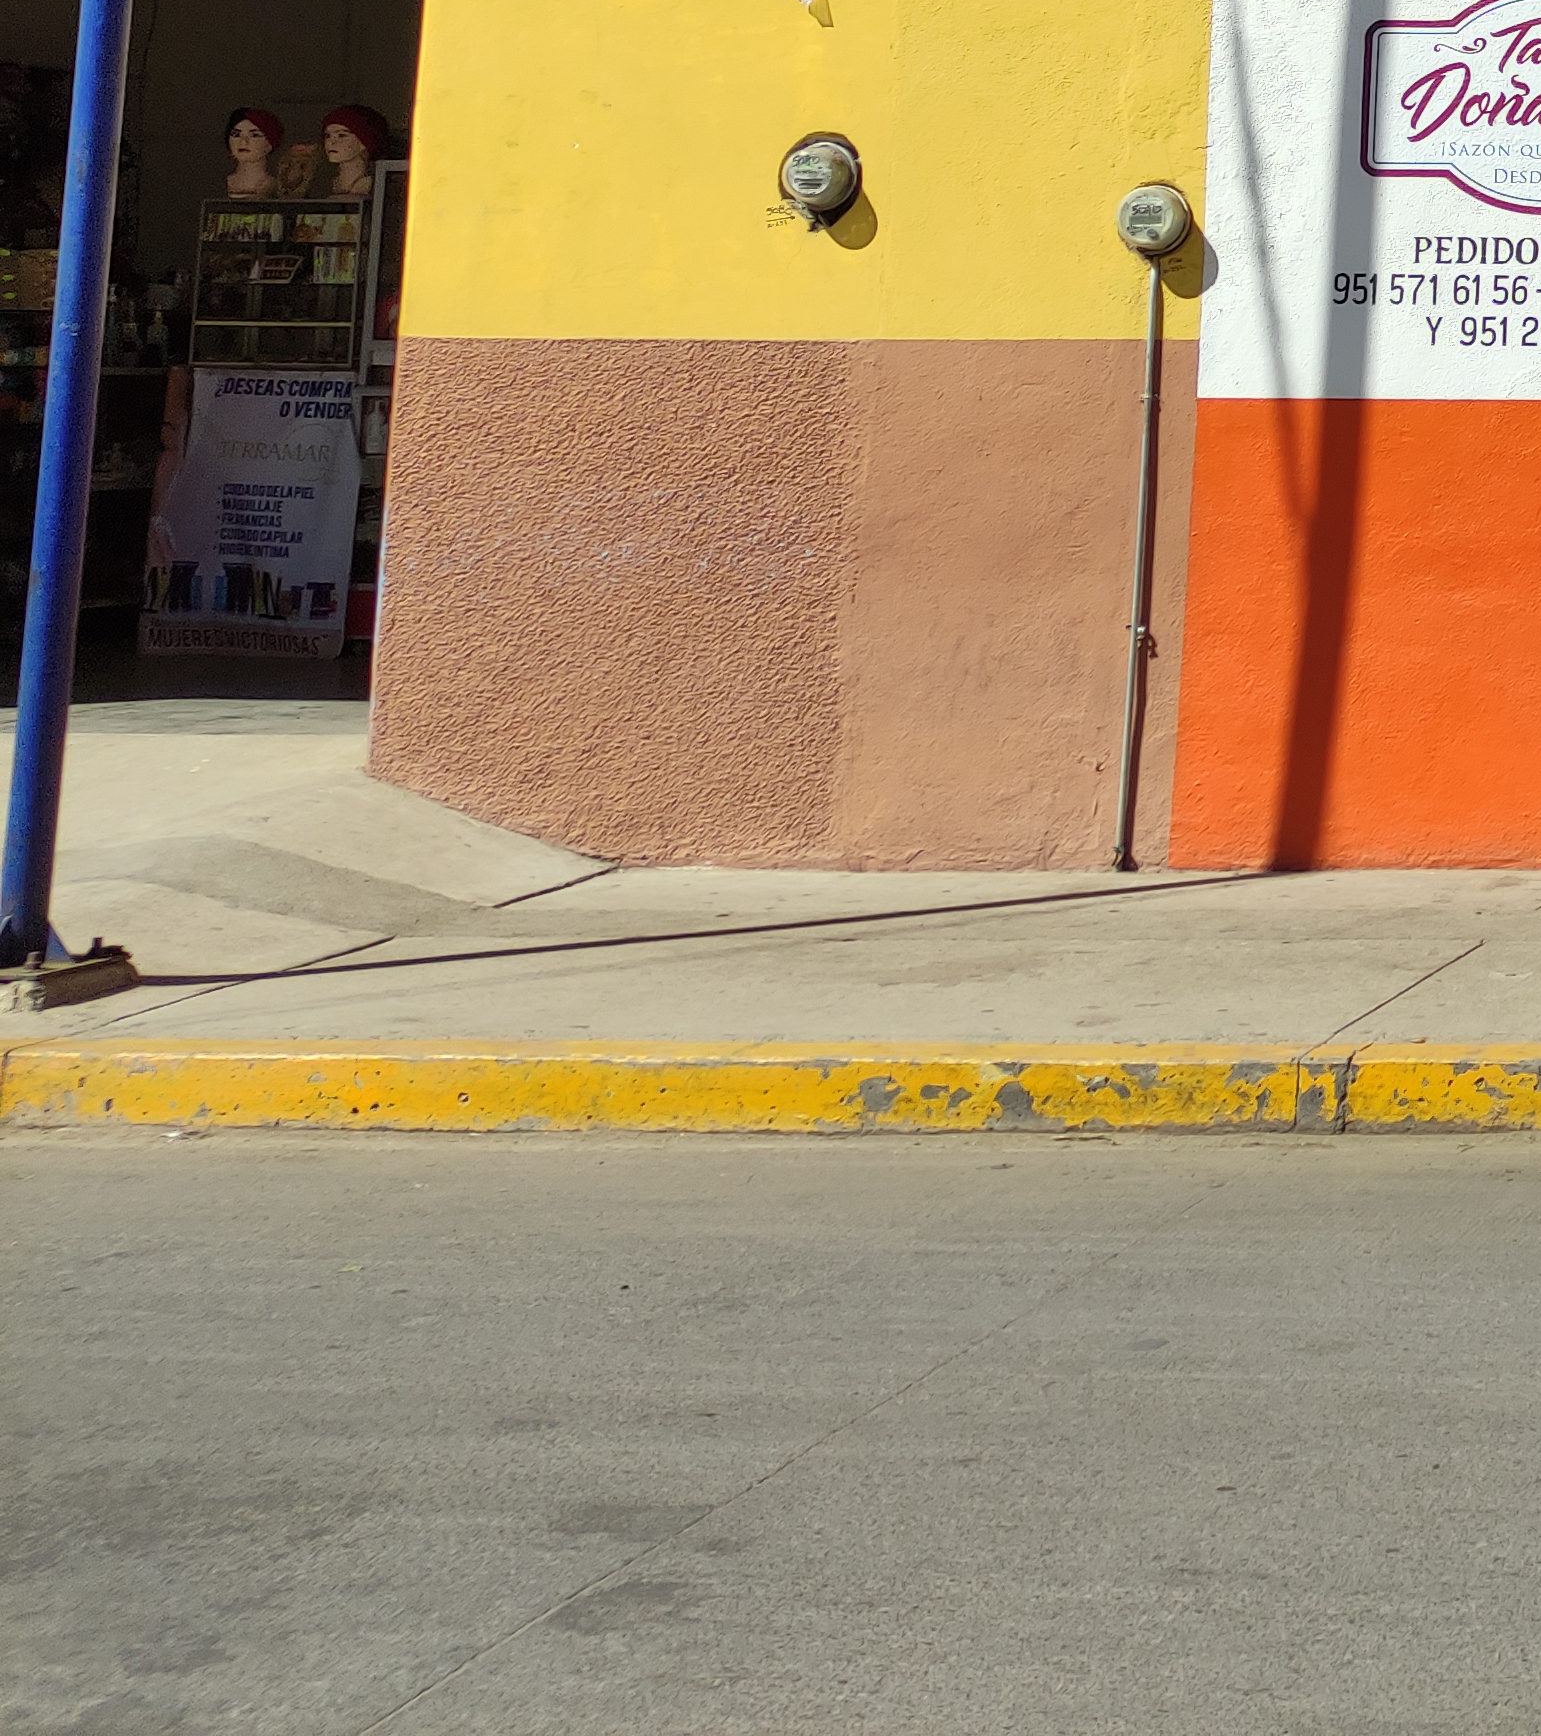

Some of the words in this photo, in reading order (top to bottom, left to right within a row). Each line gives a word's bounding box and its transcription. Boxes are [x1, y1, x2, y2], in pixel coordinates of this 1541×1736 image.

[1333, 273, 1378, 305] 951
[1389, 274, 1438, 305] 571
[1453, 274, 1481, 305] 61
[1493, 276, 1529, 305] 56
[1426, 317, 1443, 346] Y
[1459, 316, 1508, 347] 951
